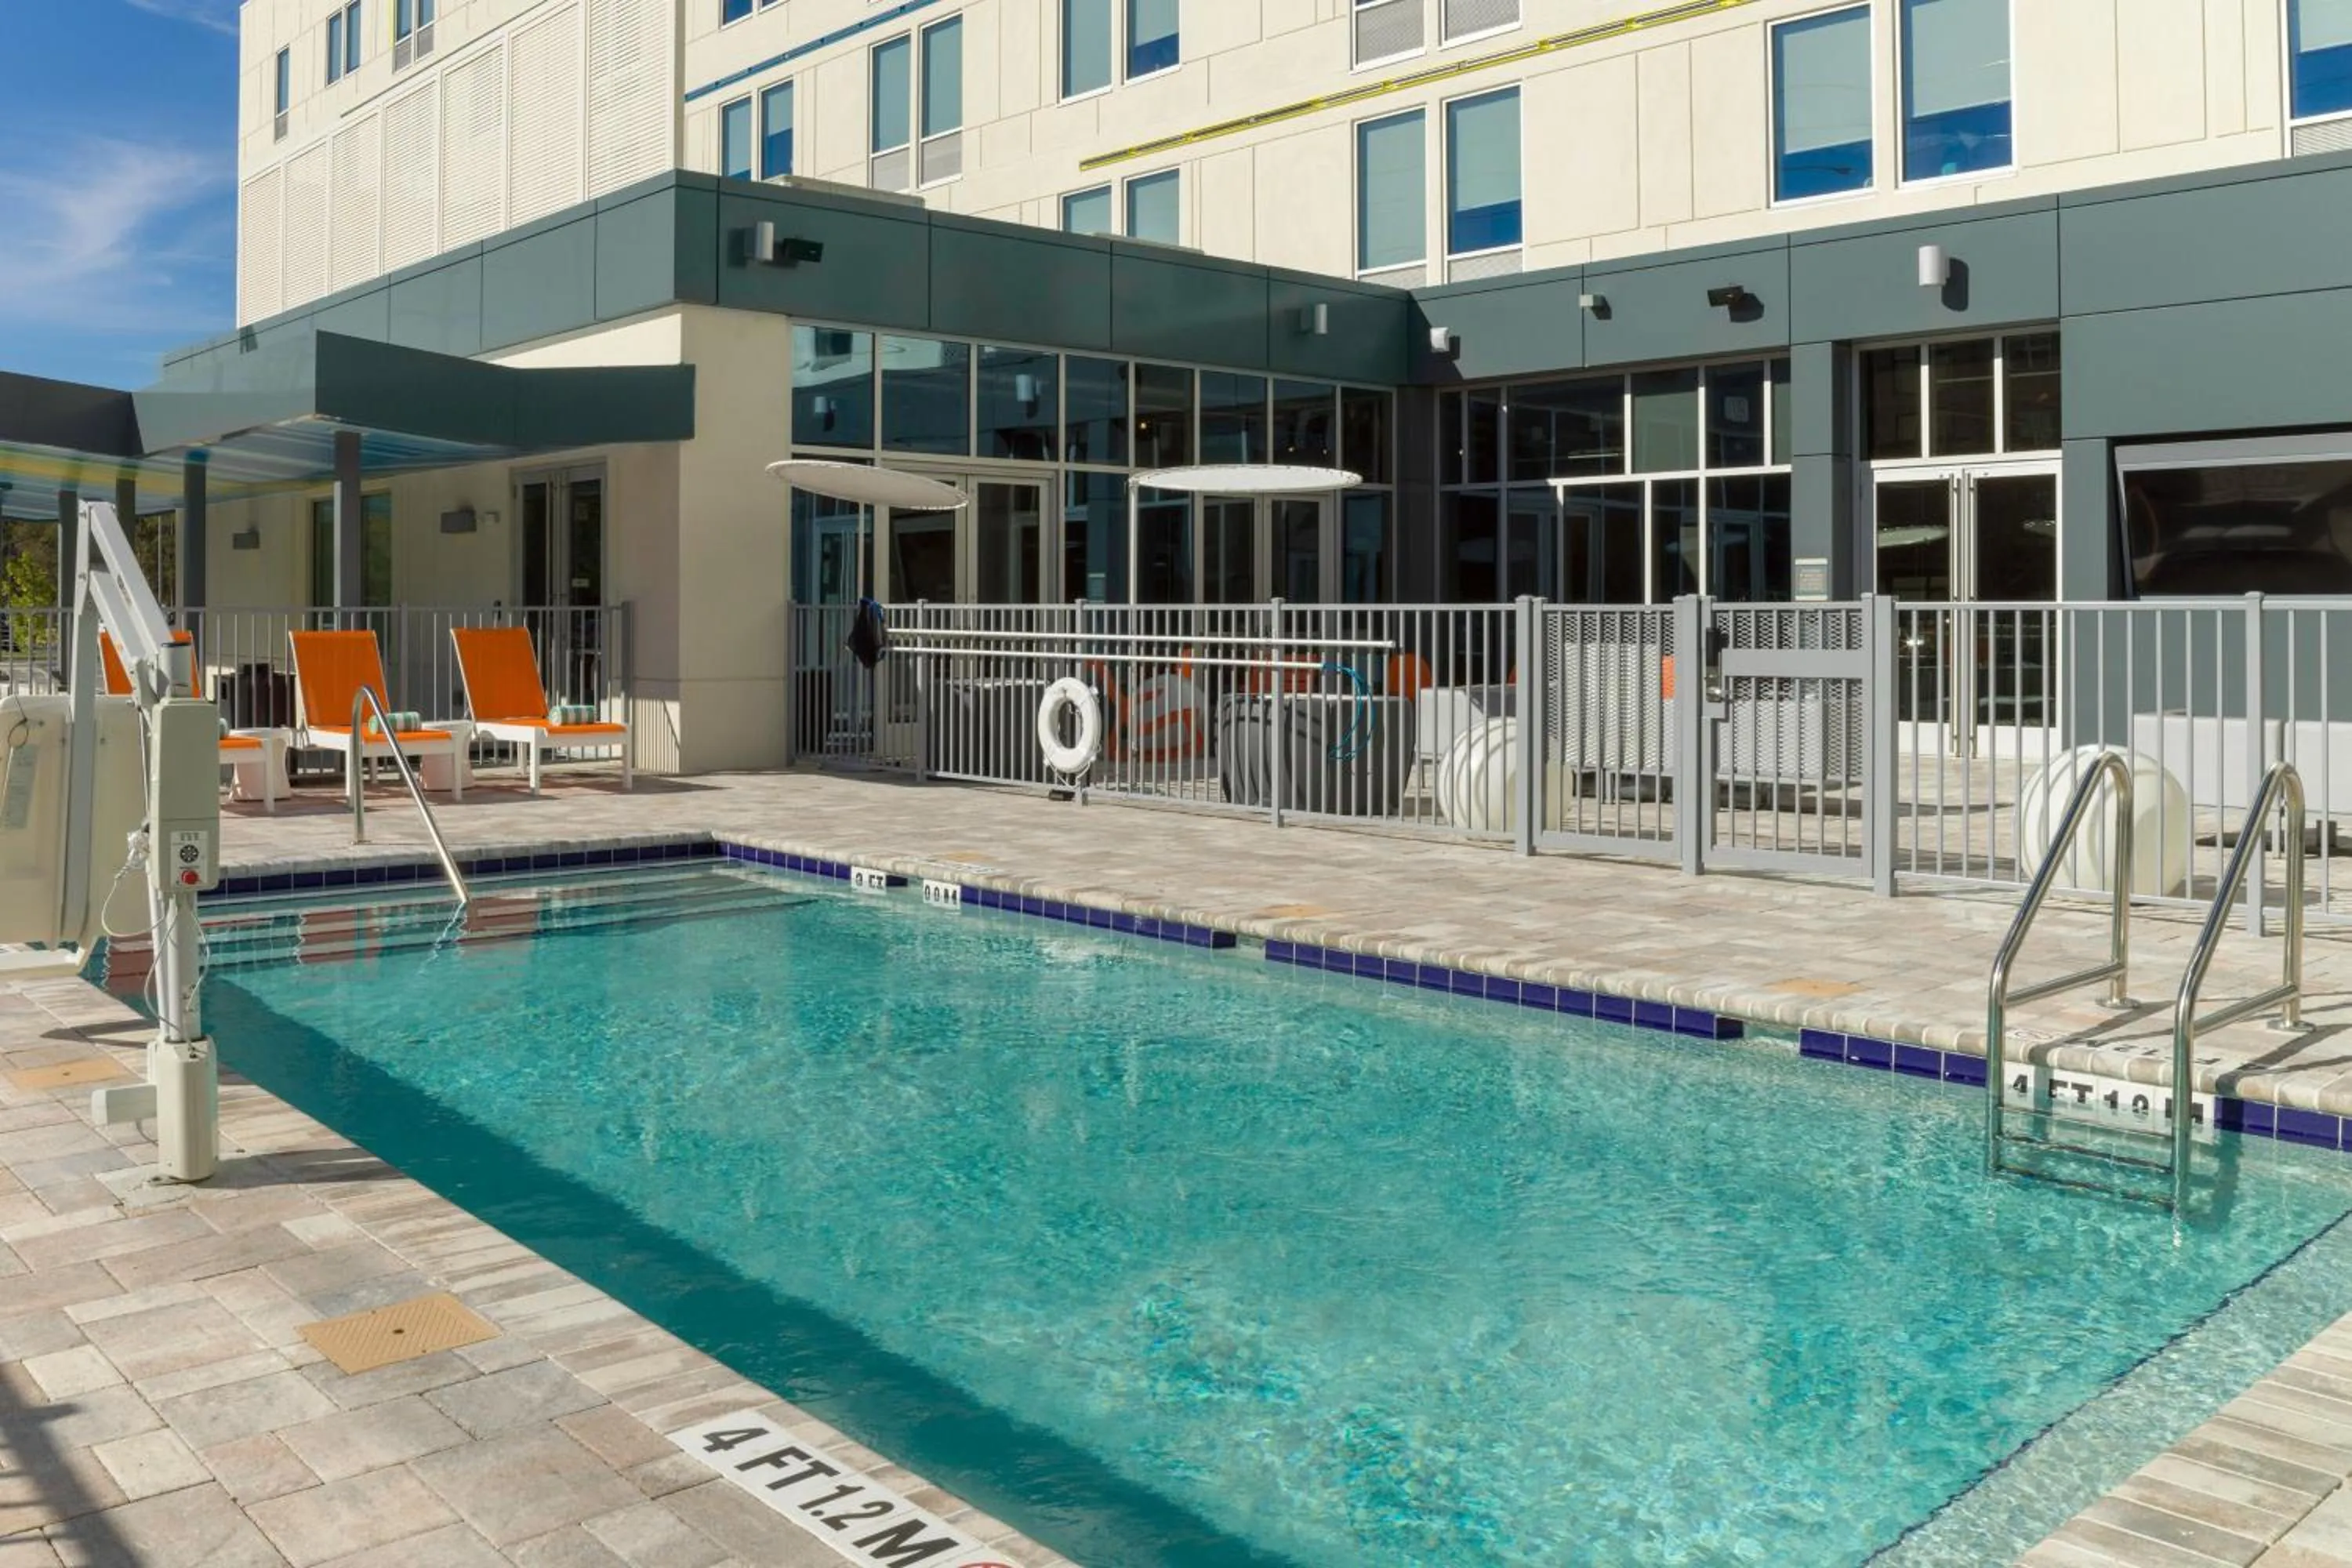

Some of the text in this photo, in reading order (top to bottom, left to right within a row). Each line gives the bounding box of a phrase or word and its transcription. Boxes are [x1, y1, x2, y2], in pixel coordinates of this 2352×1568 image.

[702, 1427, 960, 1568] 4 FT 1.2 M
